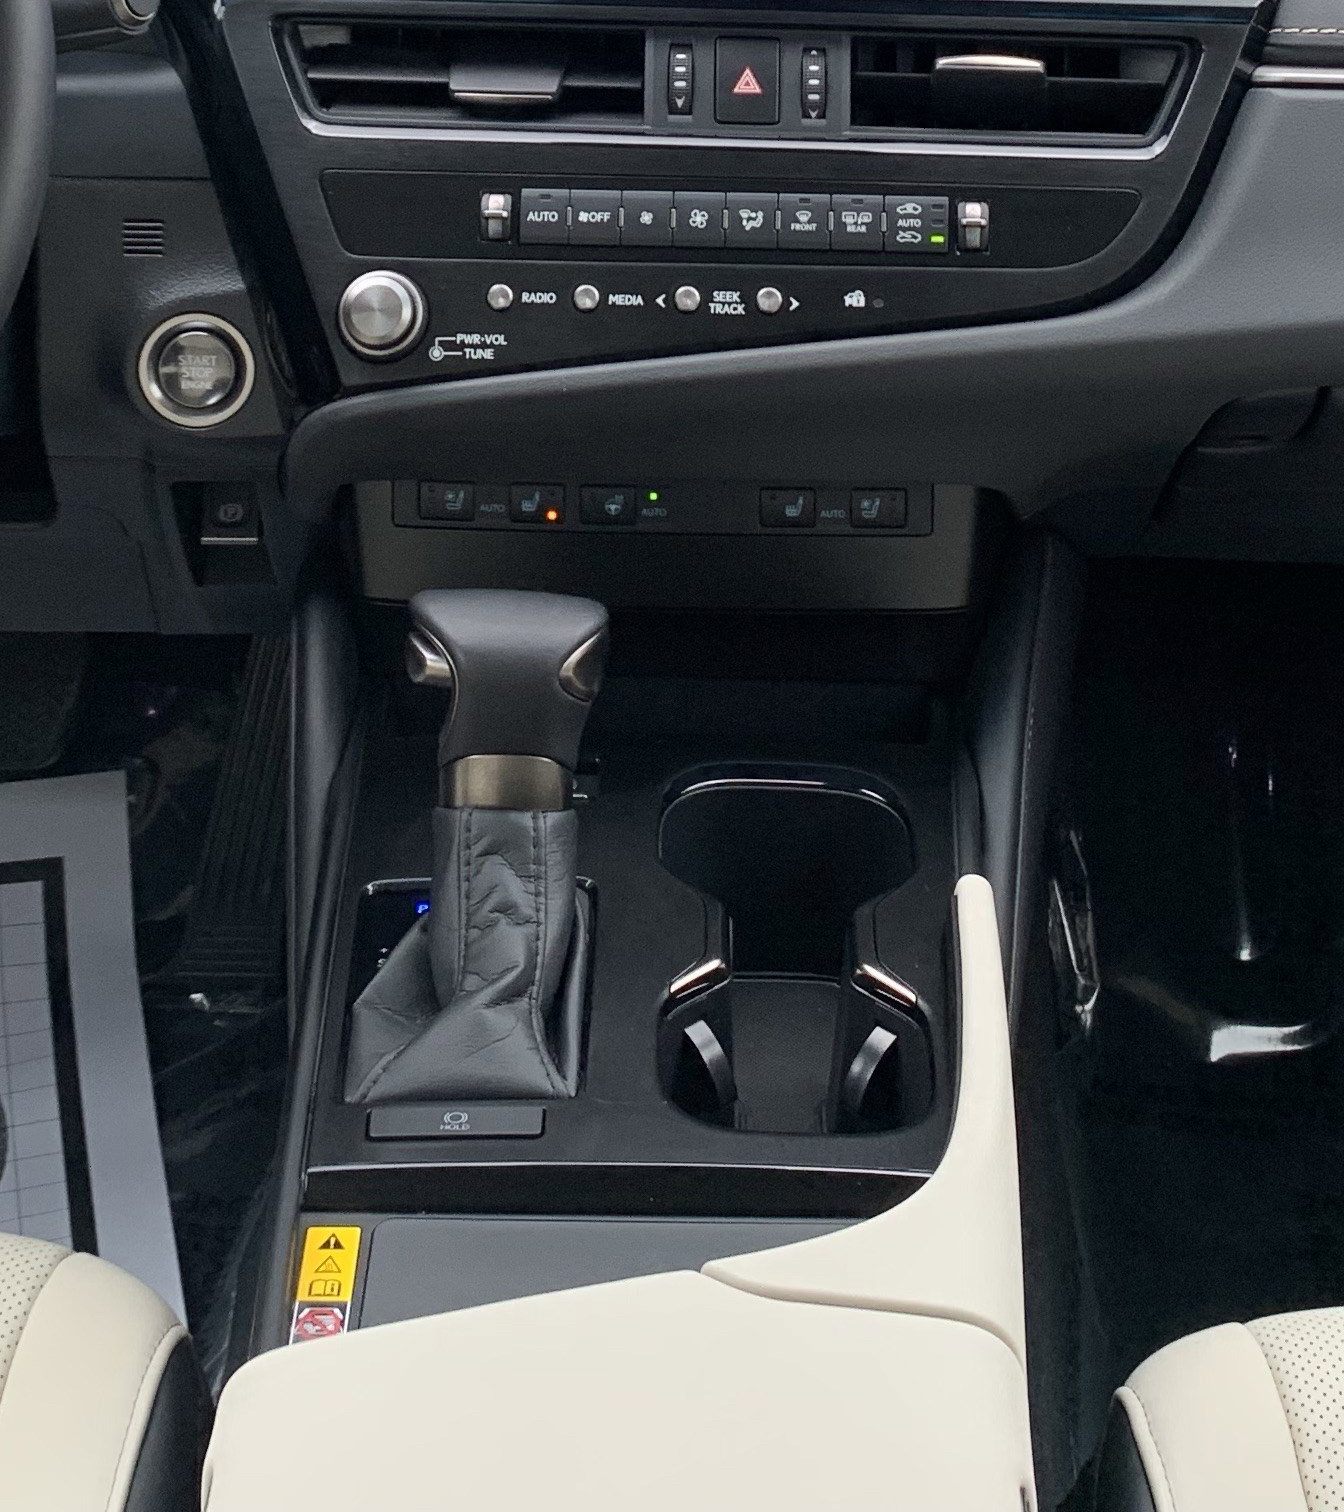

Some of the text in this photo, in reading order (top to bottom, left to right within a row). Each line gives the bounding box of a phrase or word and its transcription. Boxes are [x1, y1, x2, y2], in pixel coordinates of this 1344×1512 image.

[526, 211, 559, 222] AUTO
[588, 211, 611, 222] OFF
[790, 223, 817, 232] FRONT
[896, 218, 922, 228] AUTO
[846, 224, 867, 234] REAR
[521, 292, 557, 304] RADIO
[608, 293, 644, 306] MEDIA
[712, 290, 741, 303] SEEK
[708, 303, 746, 316] TRACK
[464, 347, 495, 360] TUNE
[177, 354, 218, 366] START
[181, 366, 214, 378] STOP
[479, 503, 506, 513] AUTO
[641, 507, 668, 517] AUTO
[819, 509, 846, 519] AUTO
[439, 1123, 471, 1131] HOLD
